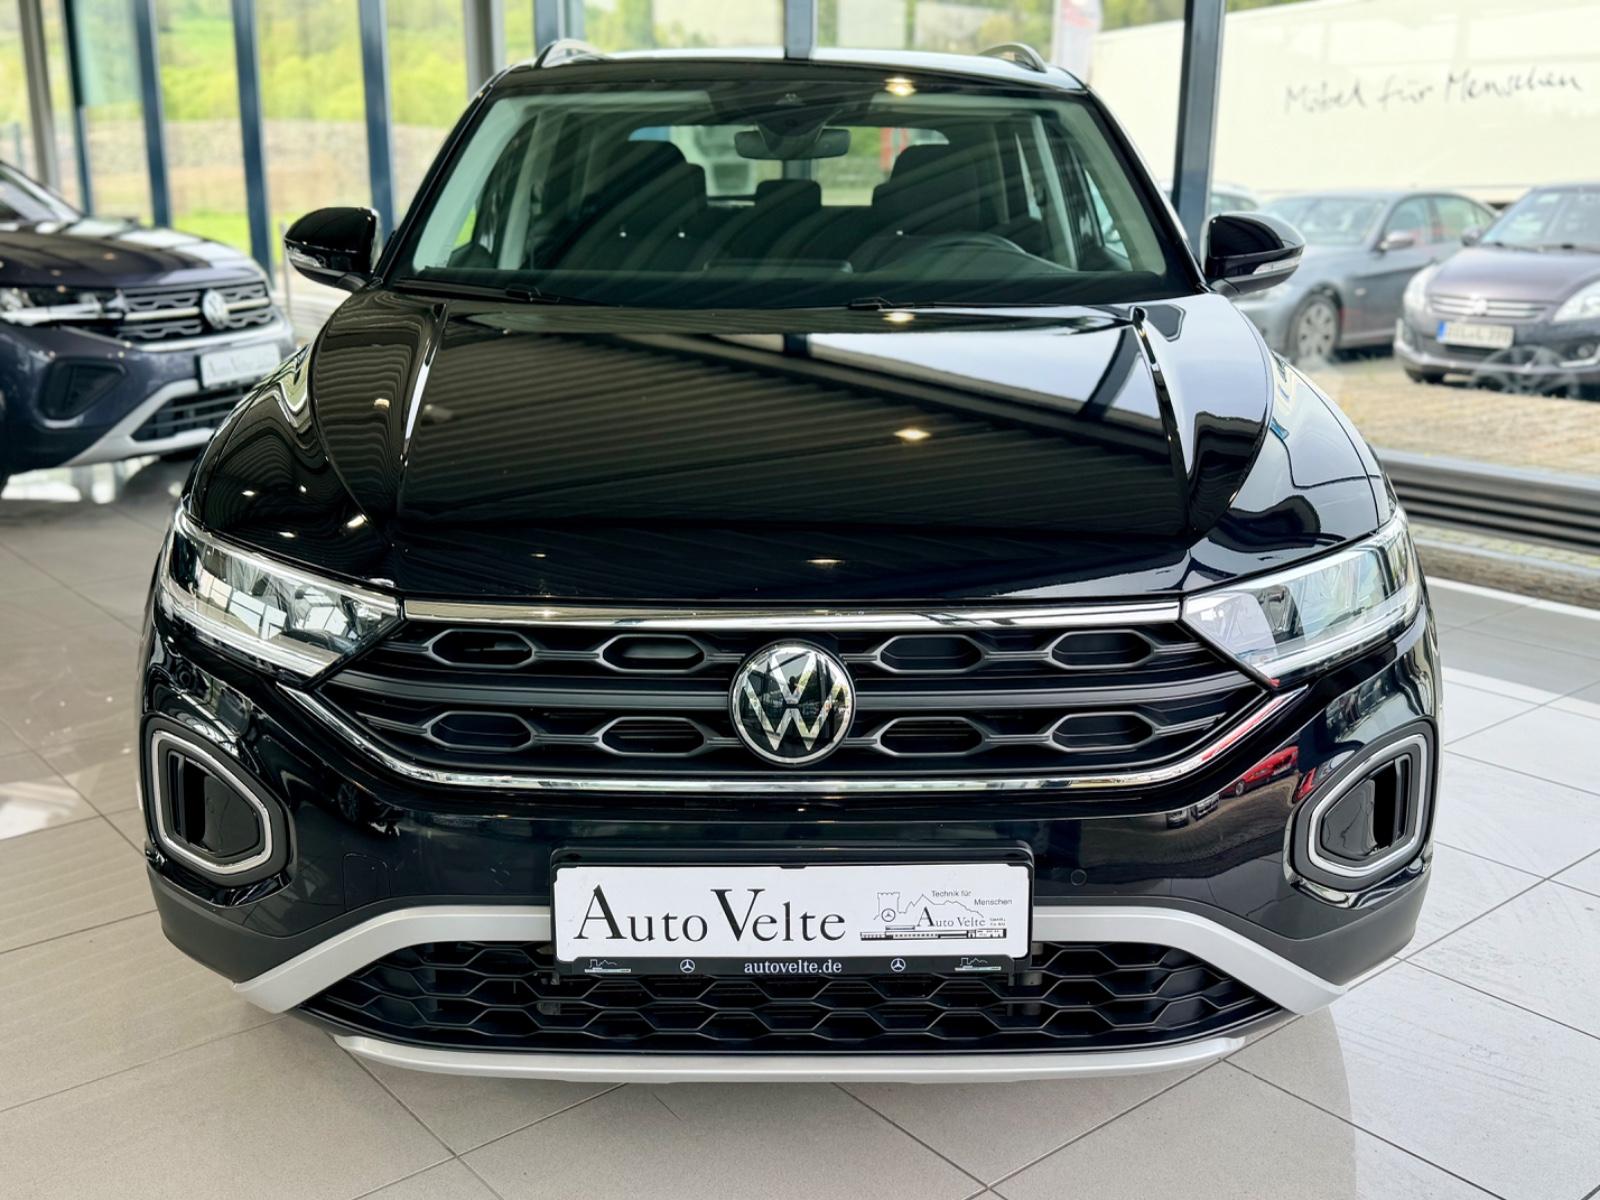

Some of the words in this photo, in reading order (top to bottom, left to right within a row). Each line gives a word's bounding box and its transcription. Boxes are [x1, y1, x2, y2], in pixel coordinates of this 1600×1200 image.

[1377, 74, 1434, 111] für
[1445, 66, 1582, 102] Menschen
[739, 648, 847, 753] VW
[573, 884, 708, 942] Auto
[710, 888, 846, 942] Velte
[916, 906, 954, 927] Auto
[957, 916, 986, 927] Velte
[743, 959, 842, 975] autovelte.de
